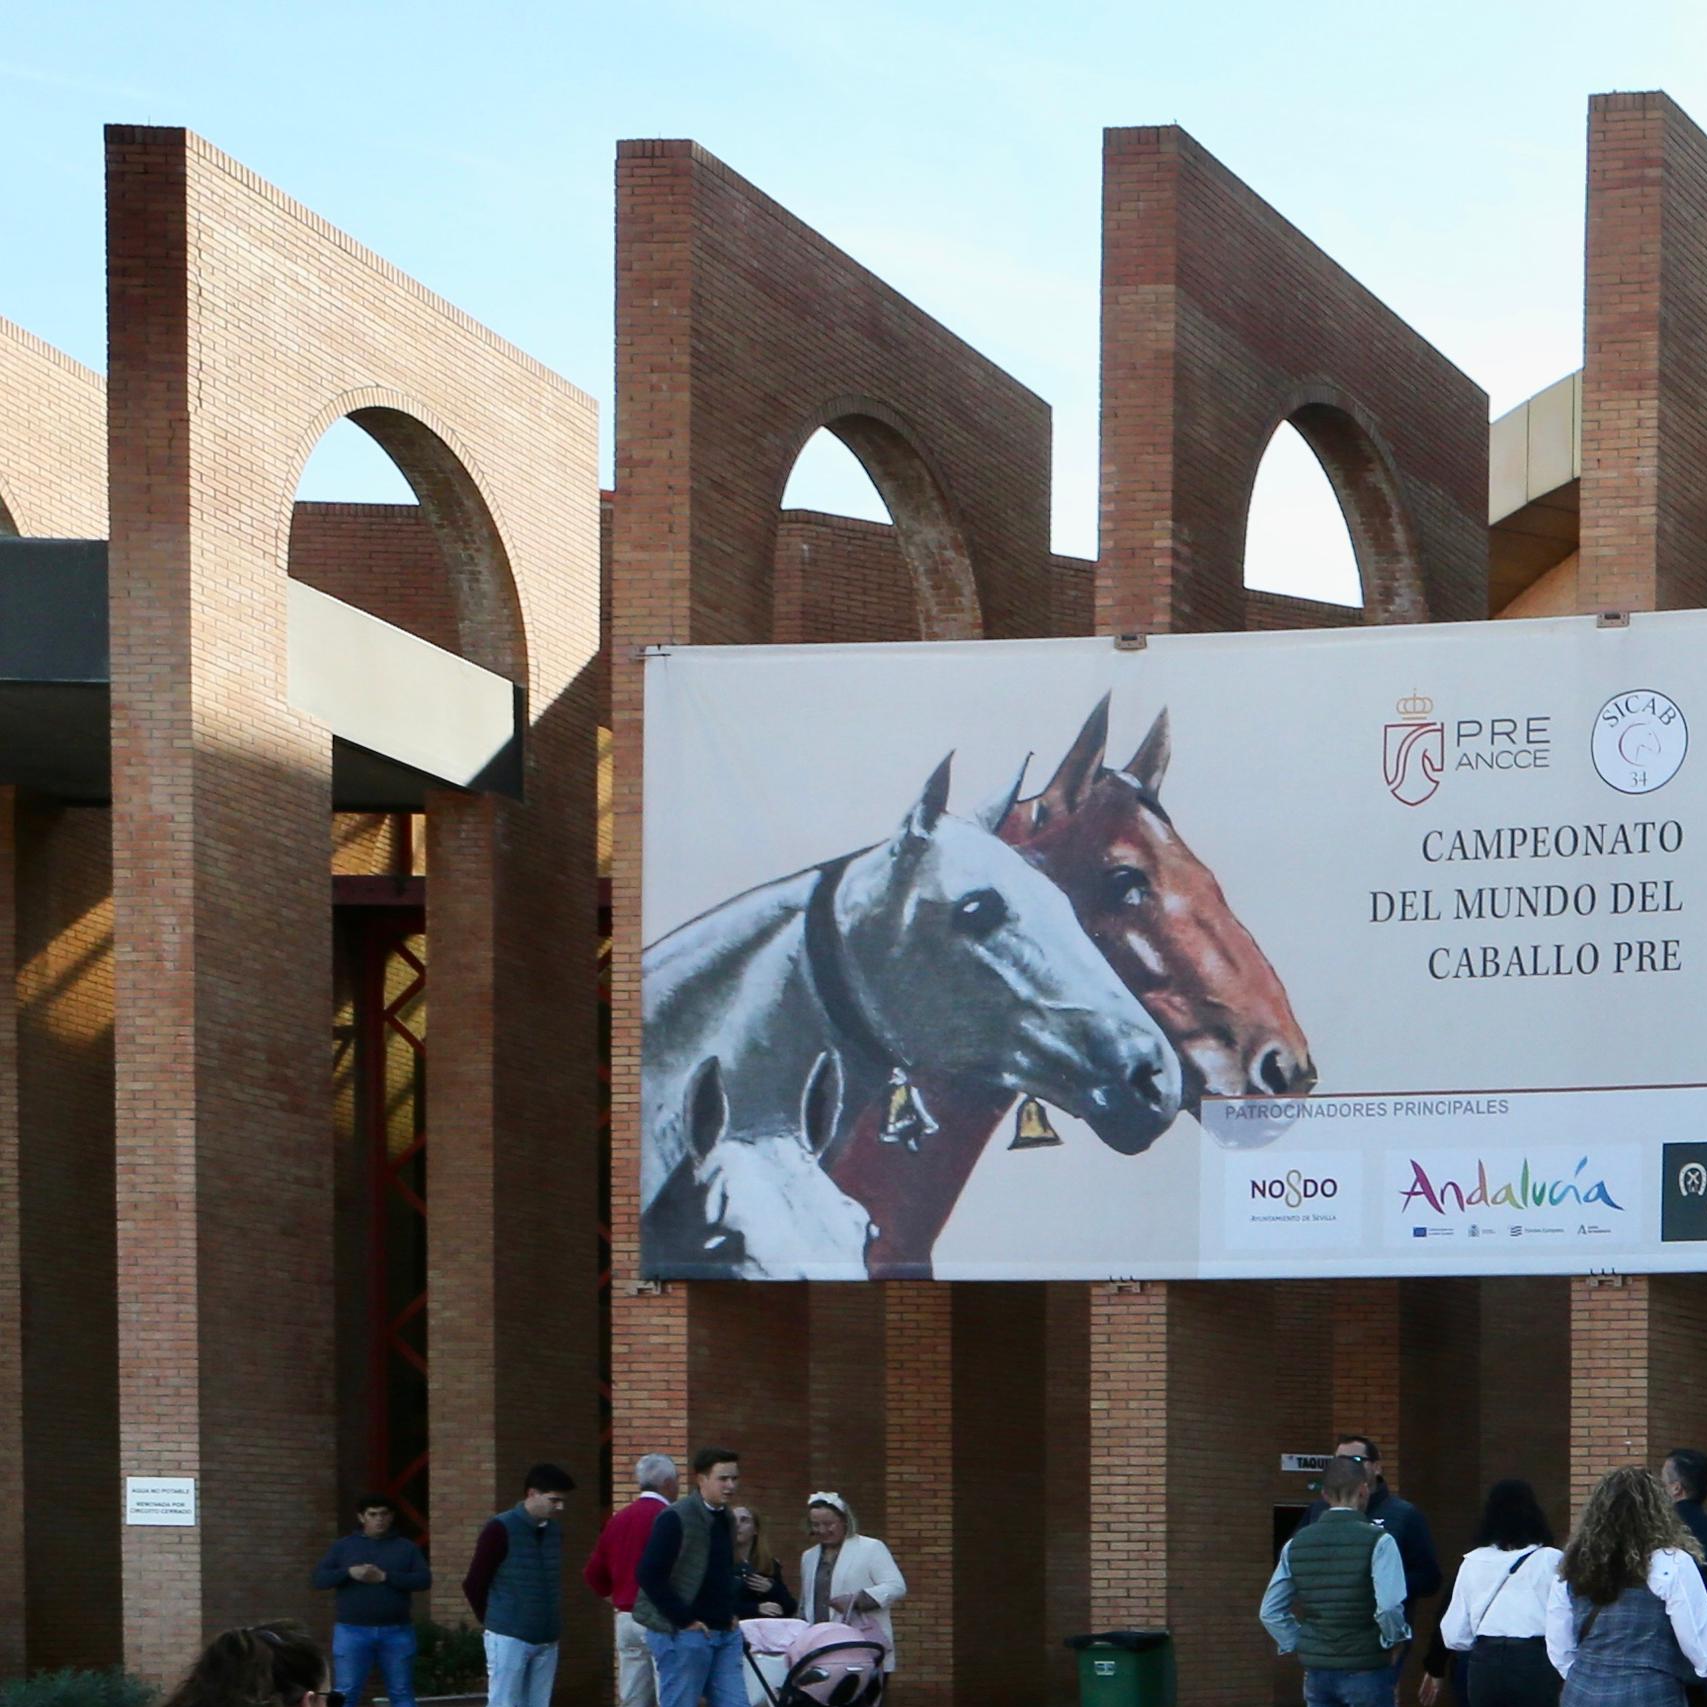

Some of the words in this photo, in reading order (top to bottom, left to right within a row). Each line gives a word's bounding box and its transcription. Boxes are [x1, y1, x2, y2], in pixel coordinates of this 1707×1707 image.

[1602, 694, 1677, 728] SICAB
[1456, 717, 1551, 747] PRE
[1455, 749, 1551, 771] ANCCE
[1630, 772, 1648, 788] 34
[1422, 820, 1684, 863] CAMPEONATO
[1369, 890, 1441, 923] DEL
[1453, 883, 1597, 920] MUNDO
[1610, 880, 1684, 914] DEL
[1428, 942, 1599, 980] CABALLO
[1613, 939, 1682, 974] PRE
[1226, 1102, 1388, 1120] PATROCINADORES
[1393, 1098, 1510, 1116] PRINCIPALES
[1399, 1155, 1625, 1216] Andalucía
